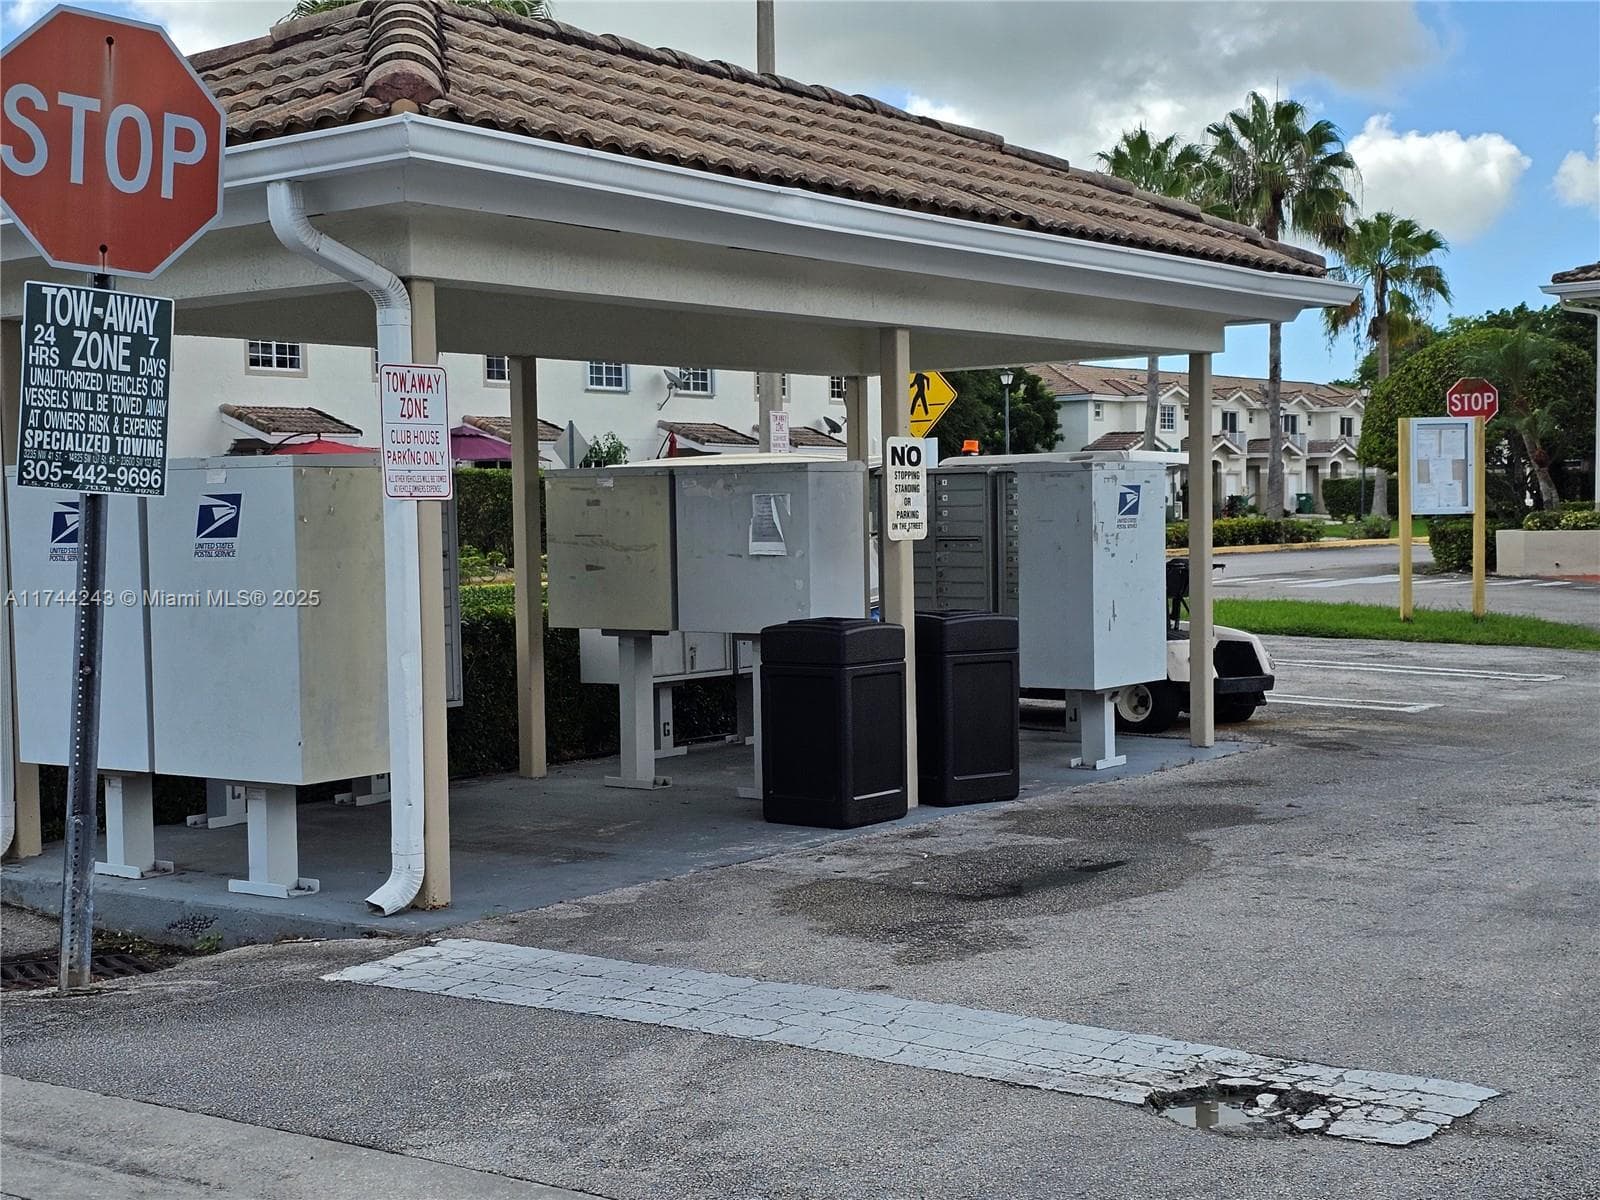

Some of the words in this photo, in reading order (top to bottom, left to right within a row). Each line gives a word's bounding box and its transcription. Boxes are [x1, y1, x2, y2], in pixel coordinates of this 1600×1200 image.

[0, 82, 207, 200] STOP
[41, 286, 159, 335] TOW-AWAY
[34, 324, 56, 345] 24
[28, 345, 60, 367] HRS
[71, 329, 132, 372] ZONE
[148, 336, 160, 356] 7
[139, 356, 166, 378] DAYS
[30, 366, 103, 392] UNAUTHORIZED
[106, 373, 148, 396] VEHICLES
[151, 379, 164, 398] OR
[410, 372, 441, 395] AWAY
[25, 387, 69, 409] VESSELS
[72, 391, 94, 411] WILL
[96, 394, 109, 412] BE
[112, 395, 142, 415] TOWED
[145, 399, 167, 417] AWAY
[399, 397, 429, 420] ZONE
[1450, 391, 1495, 412] STOP
[27, 409, 41, 428] AT
[43, 410, 86, 432] OWNERS
[88, 414, 110, 433] RISK
[112, 416, 120, 434] &
[123, 417, 162, 437] EXPENSE
[24, 429, 111, 454] SPECIALIZED
[115, 436, 163, 458] TOWING
[390, 429, 412, 445] CLUB
[413, 430, 441, 446] HOUSE
[387, 450, 421, 465] PARKING
[423, 450, 445, 466] ONLY
[891, 444, 922, 468] NO
[22, 459, 162, 489] 305-442-9696
[894, 470, 921, 481] STOPPING
[894, 484, 921, 494] STANDING
[903, 497, 912, 507] OR
[896, 510, 920, 519] PARKING
[892, 522, 898, 530] ON
[899, 522, 907, 530] THE
[908, 522, 924, 530] STREET
[194, 542, 215, 550] UNITED
[194, 550, 213, 558] POSTAL
